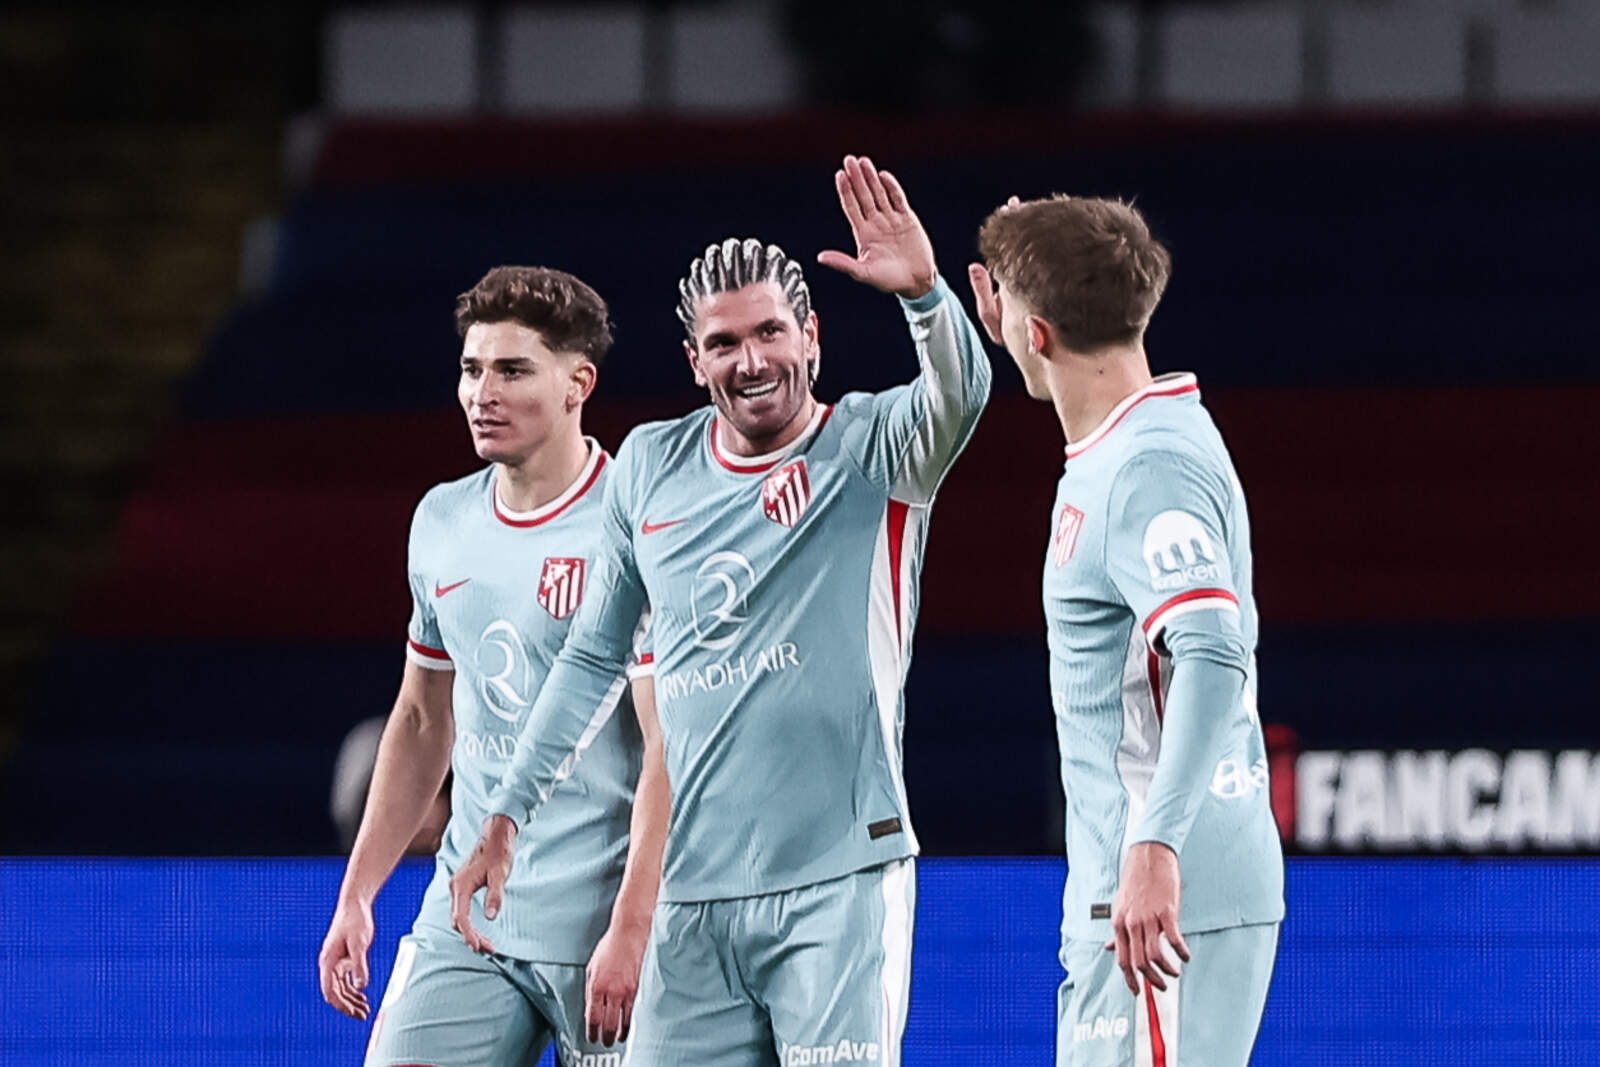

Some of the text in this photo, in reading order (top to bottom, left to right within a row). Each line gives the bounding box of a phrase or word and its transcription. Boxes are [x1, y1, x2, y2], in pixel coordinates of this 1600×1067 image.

[662, 643, 800, 701] RIYADH AIR
[461, 731, 520, 760] RIYAD
[573, 1050, 621, 1067] Com
[788, 1039, 878, 1067] ComAve
